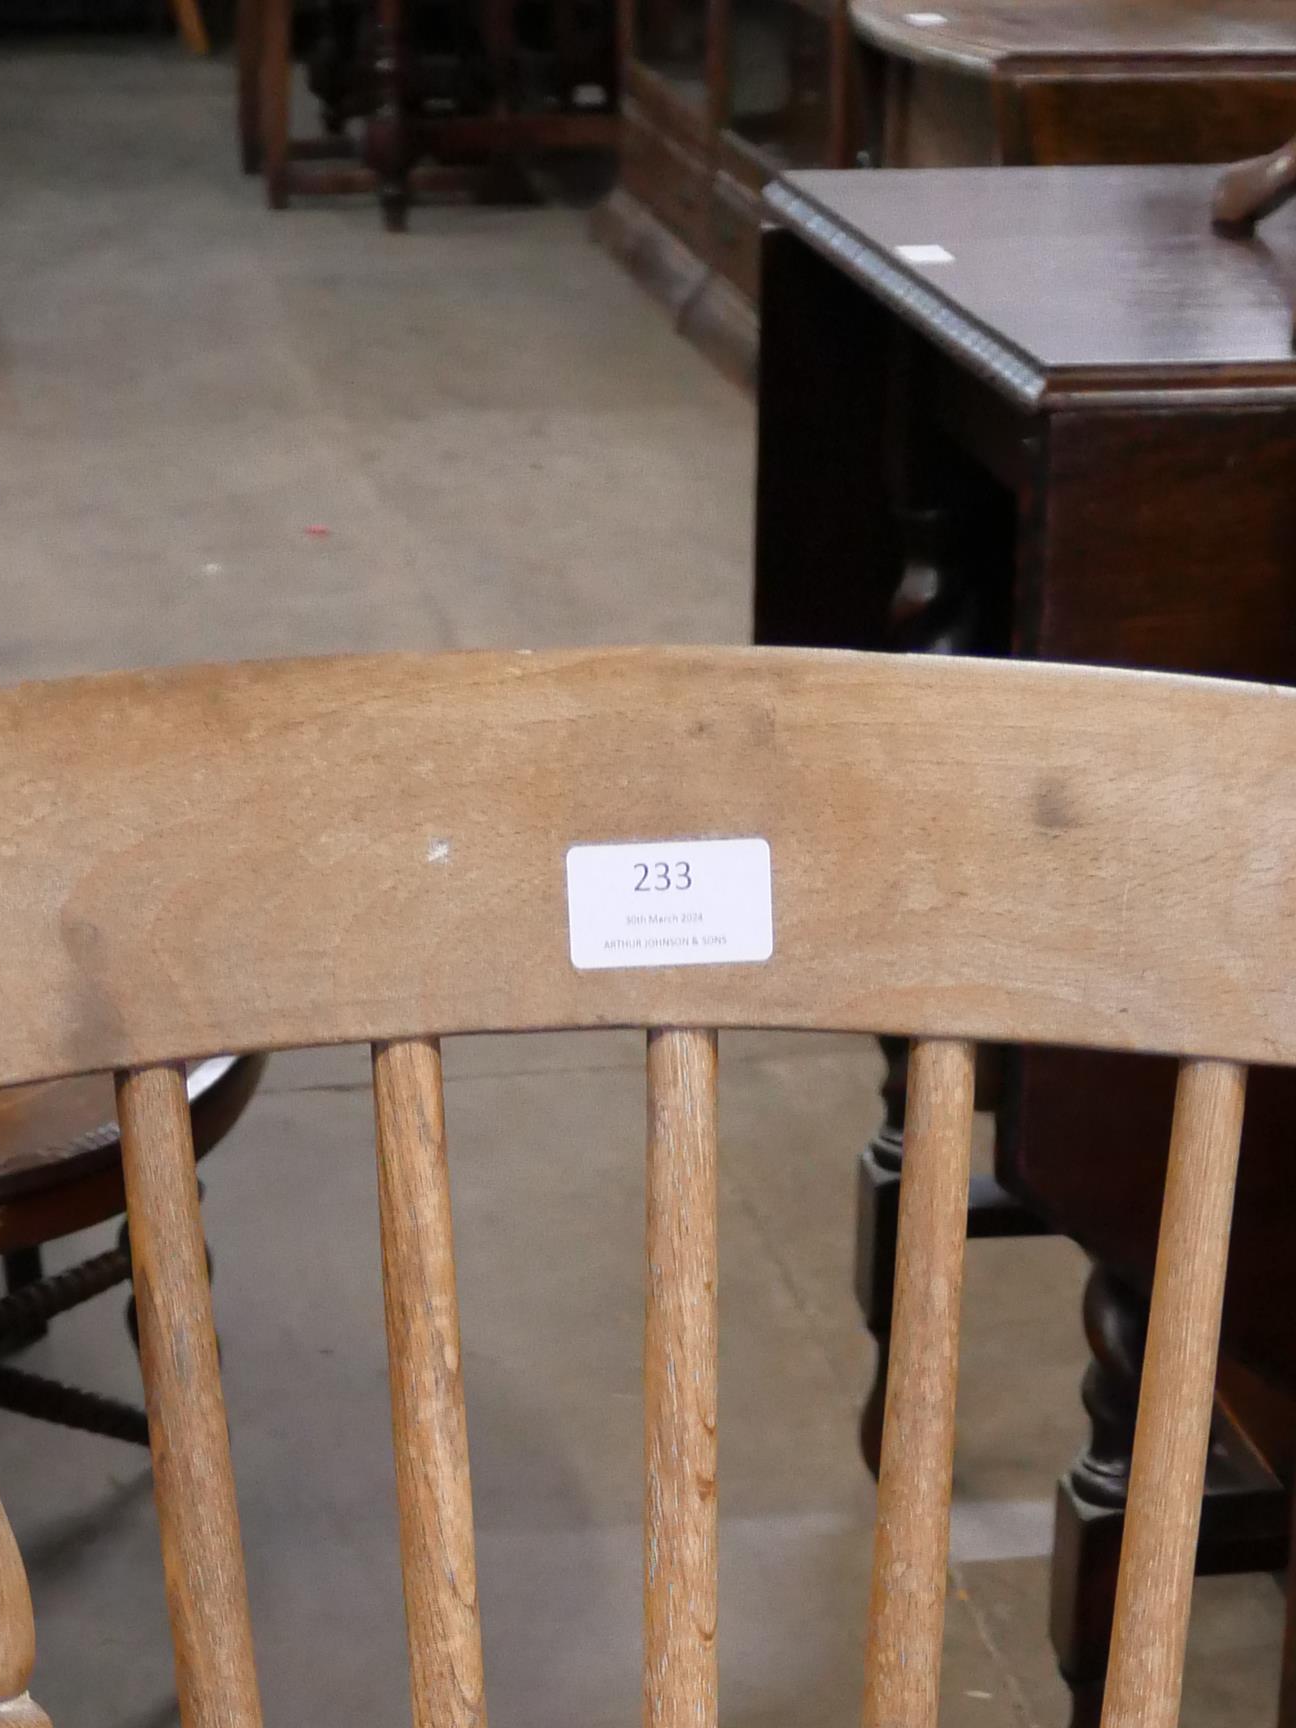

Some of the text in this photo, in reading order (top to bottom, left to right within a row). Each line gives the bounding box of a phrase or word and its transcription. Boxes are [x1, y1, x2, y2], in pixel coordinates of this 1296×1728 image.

[633, 860, 693, 893] 233
[648, 913, 679, 925] March
[681, 911, 703, 923] 2024
[604, 933, 727, 950] ARTHUR JOHNSON & SONS
